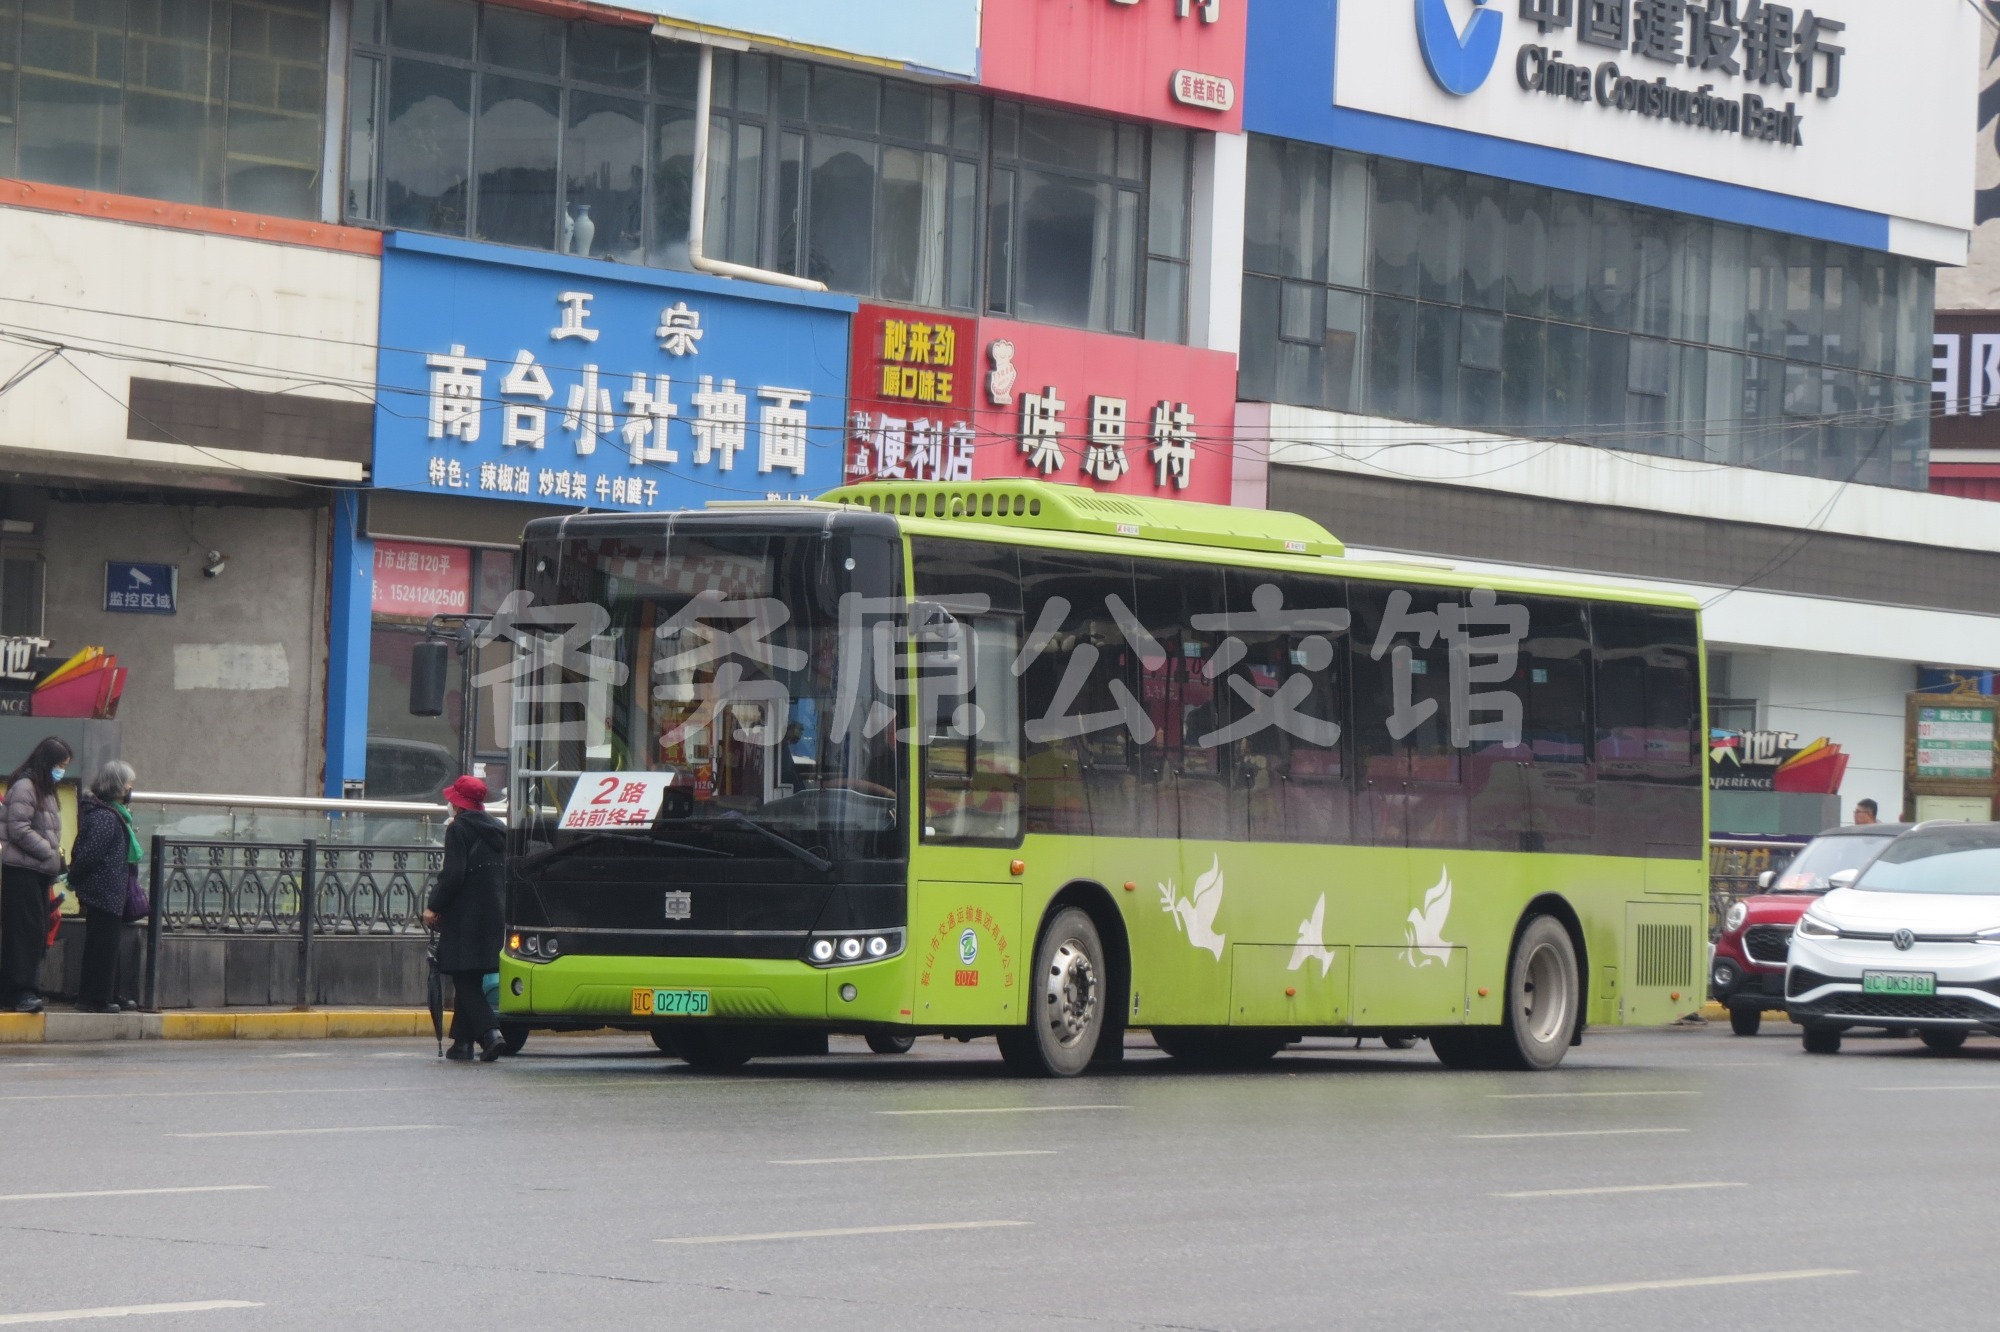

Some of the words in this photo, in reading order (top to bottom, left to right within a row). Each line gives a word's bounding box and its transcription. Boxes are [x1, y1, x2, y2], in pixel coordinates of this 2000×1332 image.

[1181, 75, 1226, 104] 蛋糕面包
[1516, 43, 1592, 102] China
[1594, 61, 1740, 133] Construction
[1741, 92, 1804, 146] Bank
[882, 365, 954, 403] 嚼口味王
[427, 343, 811, 476] 南台小杜抻面
[874, 413, 976, 482] 便利店
[1018, 385, 1197, 490] 味思特
[480, 462, 530, 494] 辣椒油
[538, 468, 587, 500] 炒鸡架
[595, 474, 659, 506] 牛肉腱子
[108, 591, 172, 609] 监控区域
[591, 776, 648, 804] 2路
[565, 808, 650, 828] 站前终点
[955, 970, 978, 986] 3074
